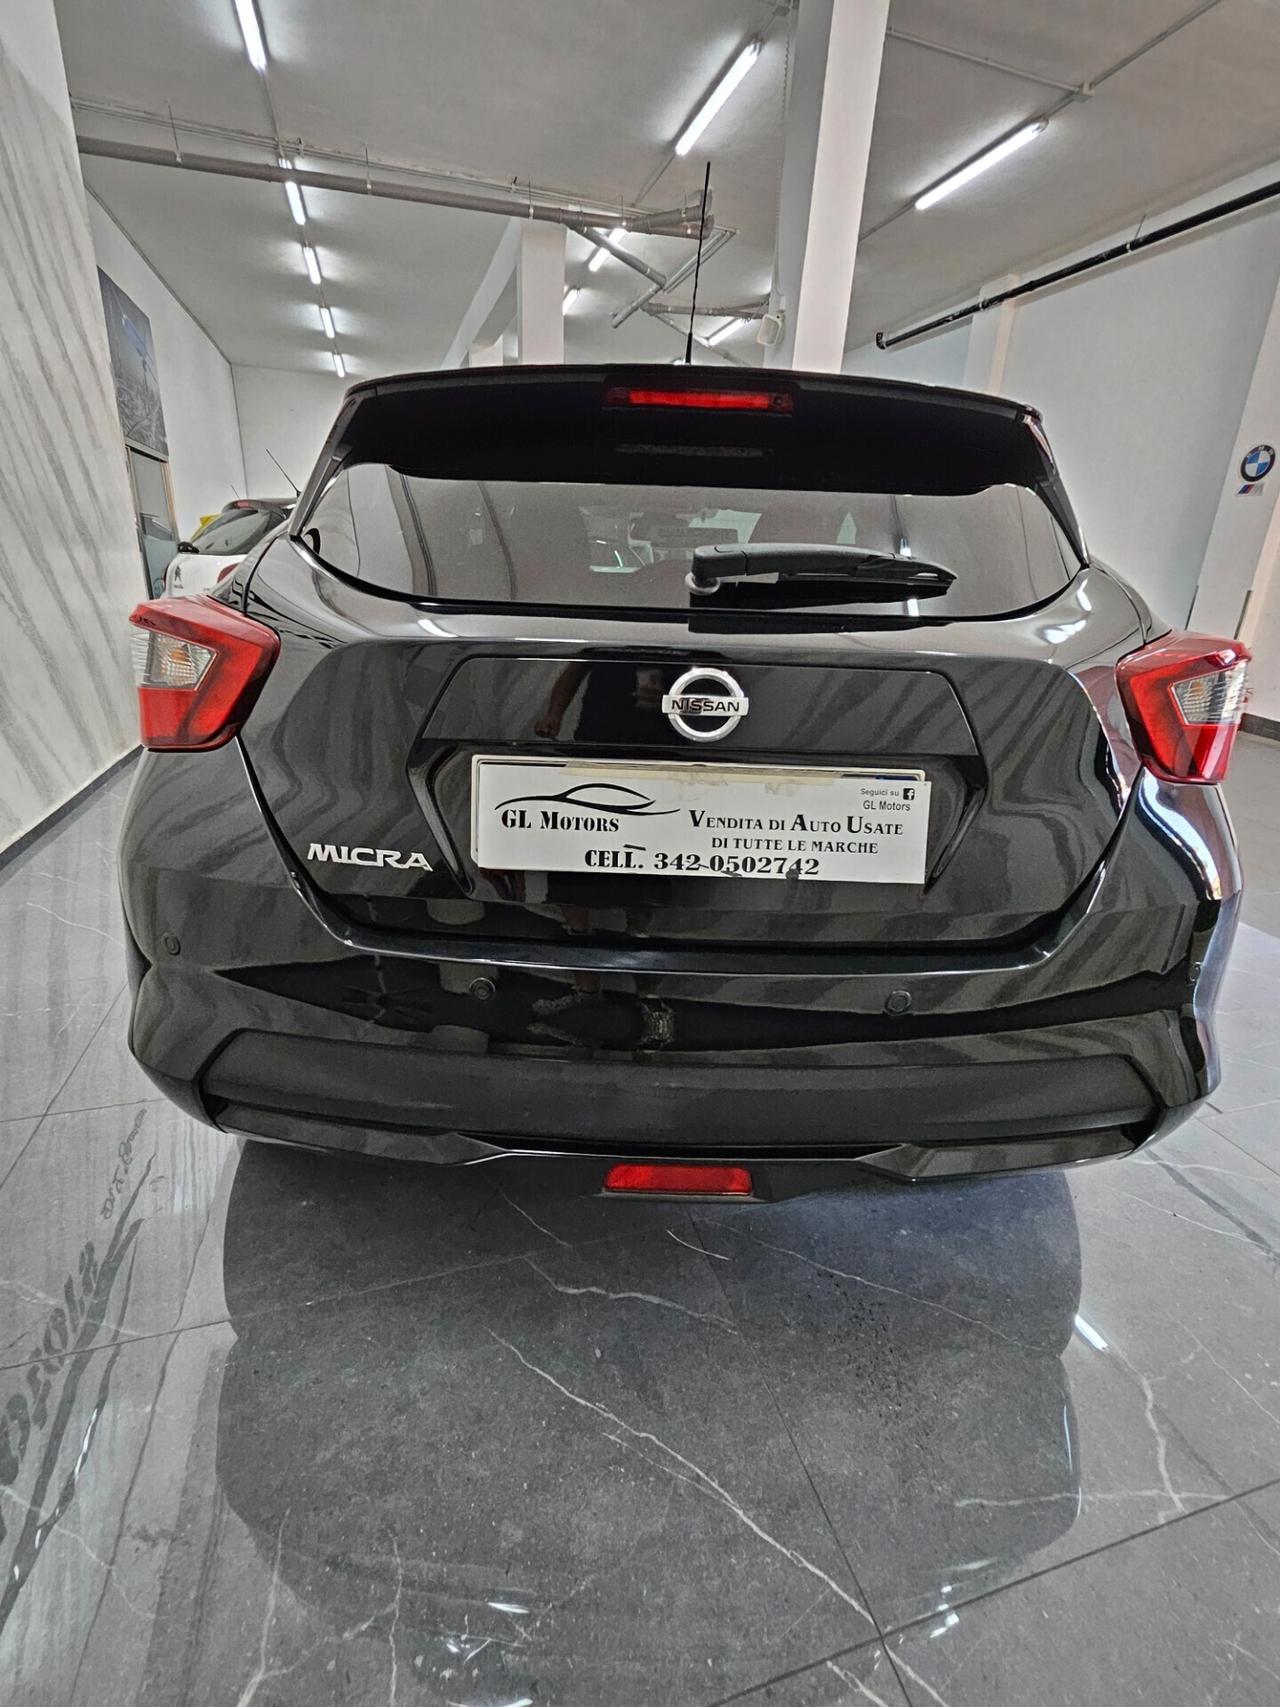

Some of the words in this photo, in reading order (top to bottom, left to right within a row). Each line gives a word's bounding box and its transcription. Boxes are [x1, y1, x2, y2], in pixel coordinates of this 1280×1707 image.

[671, 699, 740, 713] NISSAN
[860, 788, 888, 797] Seguici
[862, 799, 877, 811] GL
[879, 800, 911, 811] Motors
[501, 809, 532, 829] GL
[688, 809, 763, 830] VENDITA
[769, 819, 785, 831] DI
[711, 837, 728, 849] DI
[733, 837, 783, 851] TUTTE
[788, 839, 807, 851] LE
[811, 841, 880, 854] MARCHE
[307, 843, 433, 872] MICRA
[584, 849, 644, 869] CELL.
